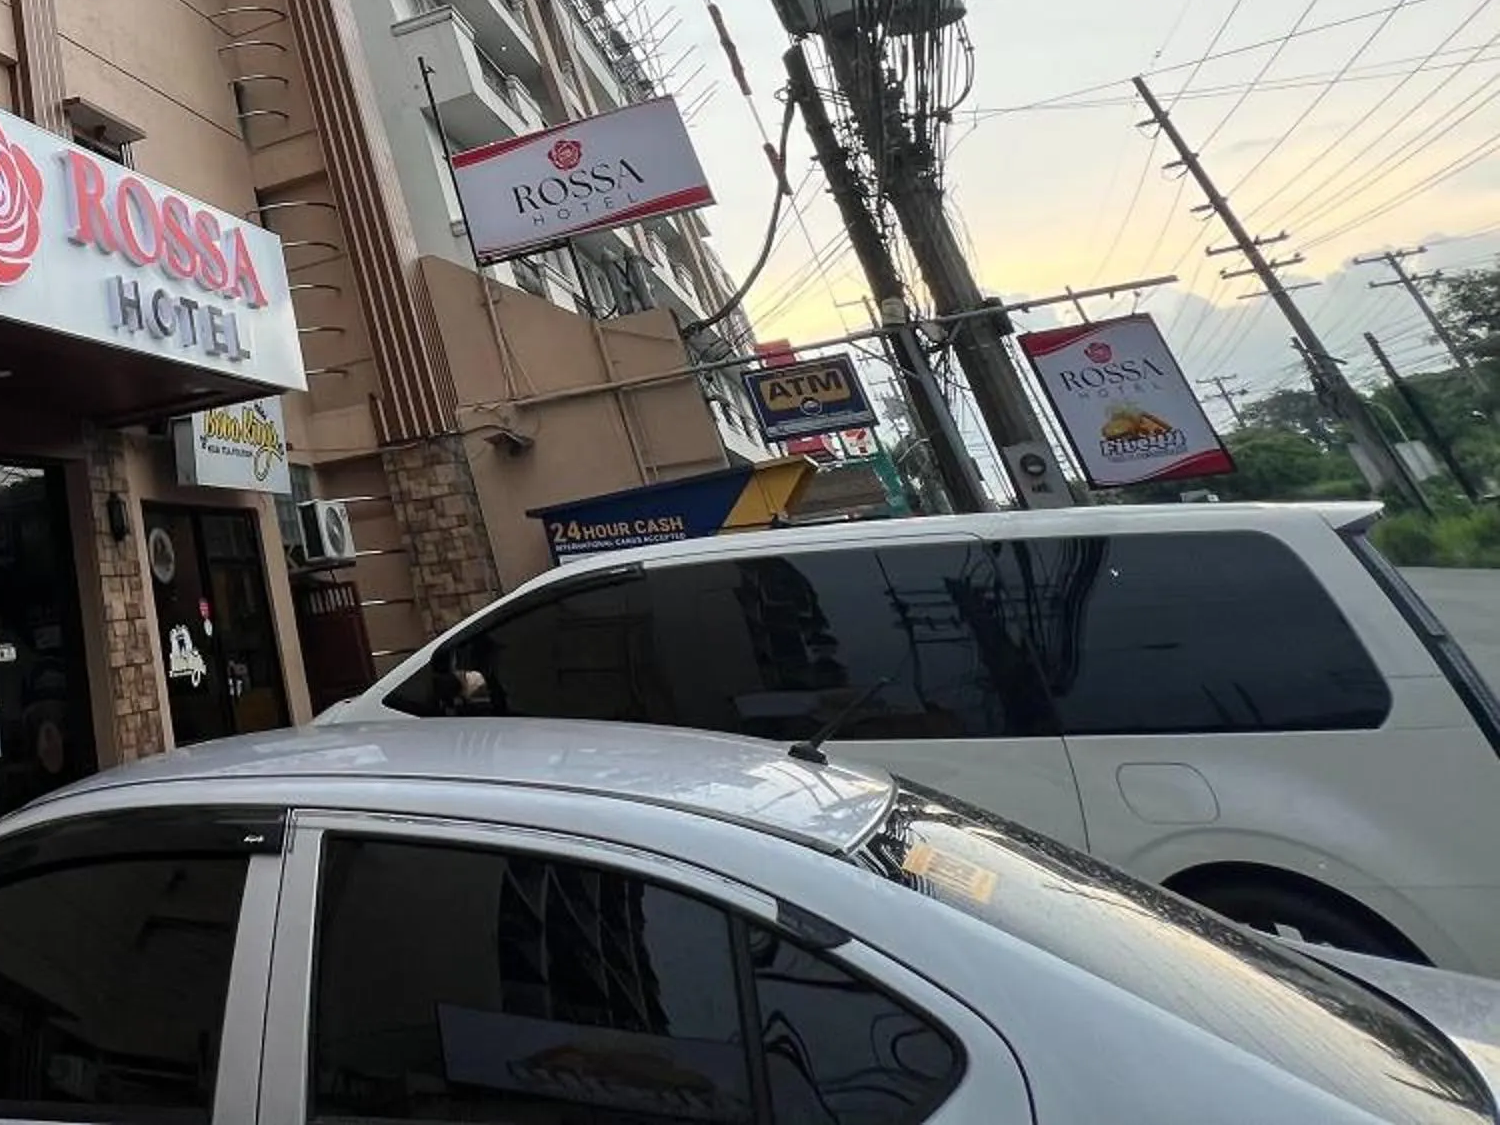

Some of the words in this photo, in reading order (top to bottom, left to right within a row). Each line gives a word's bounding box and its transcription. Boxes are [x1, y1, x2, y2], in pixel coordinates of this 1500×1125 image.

[512, 159, 644, 214] ROSSA
[533, 192, 640, 226] HOTEL
[60, 149, 268, 309] ROSSA
[112, 275, 250, 362] HOTEL
[769, 370, 843, 401] ATM
[1060, 358, 1164, 392] ROSSA
[551, 520, 581, 543] 24
[583, 522, 631, 540] HOUR
[635, 516, 684, 534] CASH
